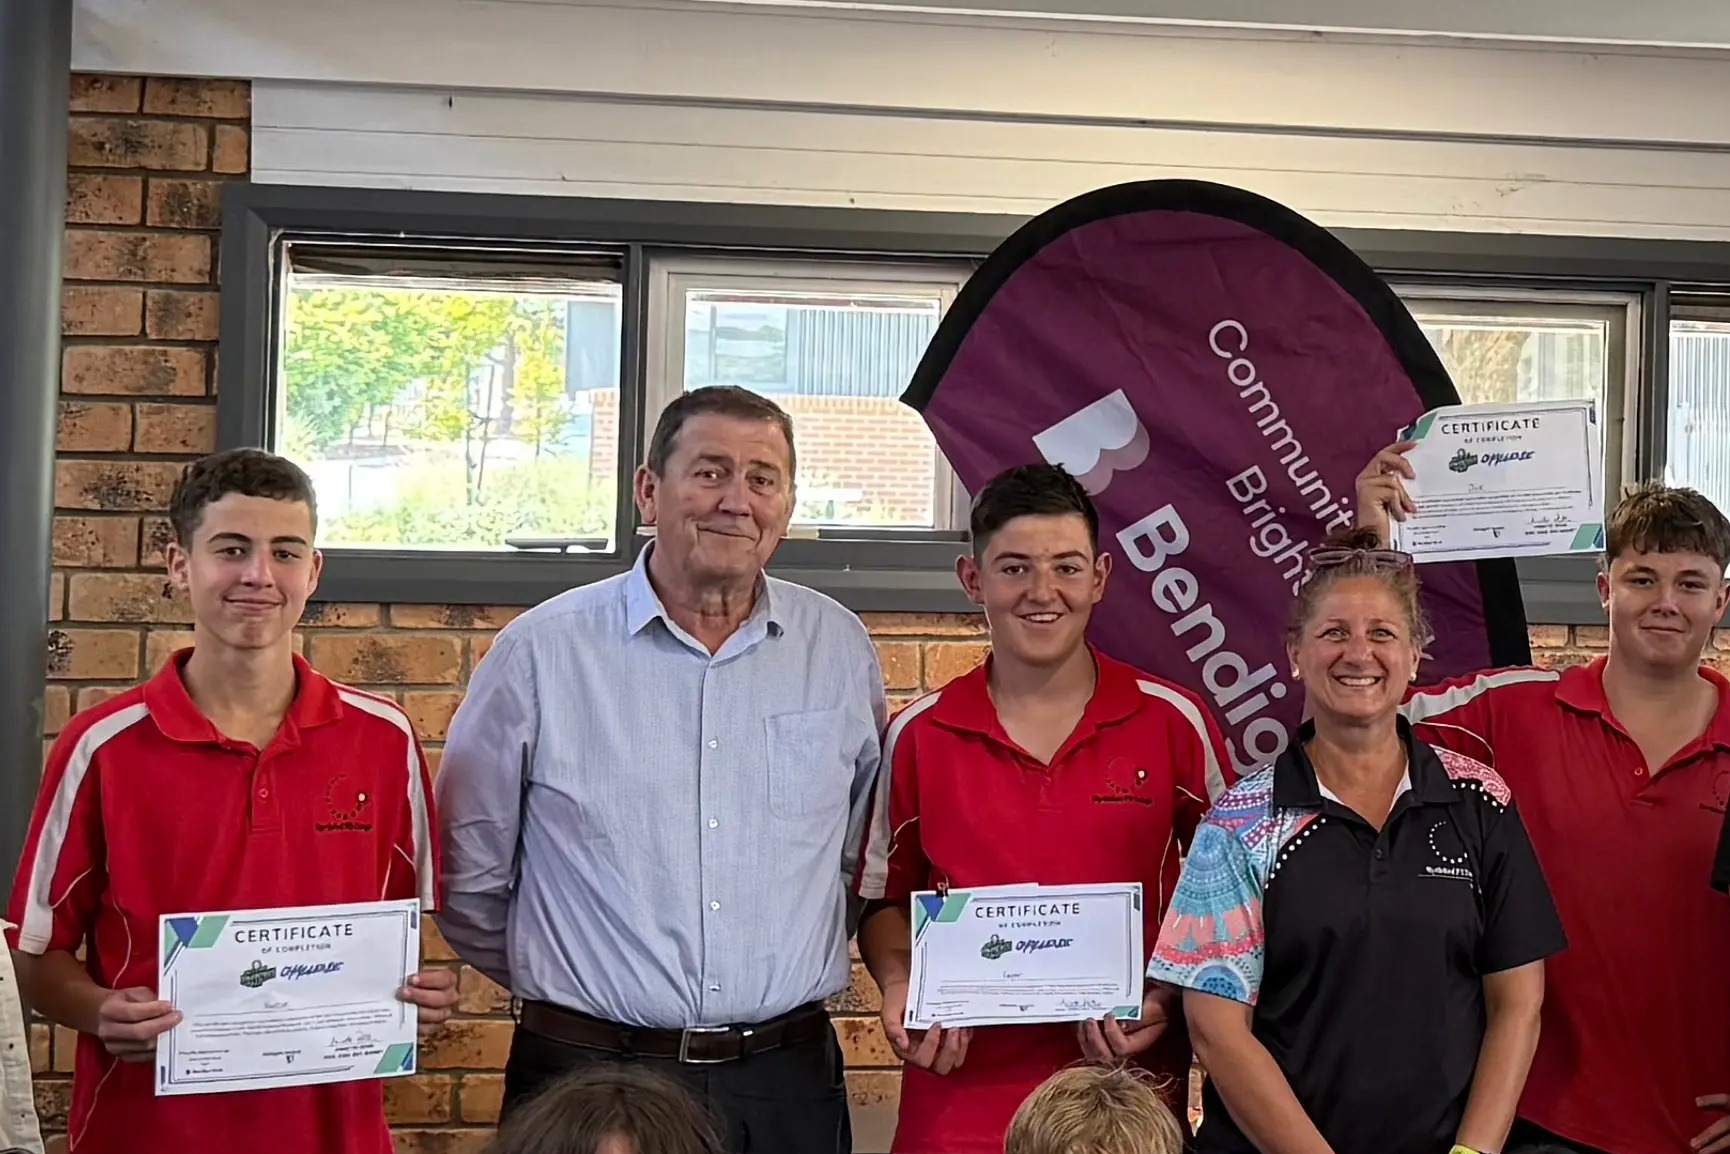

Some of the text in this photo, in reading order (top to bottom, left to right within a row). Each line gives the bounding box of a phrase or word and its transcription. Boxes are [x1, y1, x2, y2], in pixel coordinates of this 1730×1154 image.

[1208, 319, 1354, 534] Communit
[1441, 418, 1540, 434] CERTIFICATE
[1117, 504, 1288, 775] Bendig
[976, 903, 1079, 918] CERTIFICATE
[235, 924, 352, 943] CERTIFICATE
